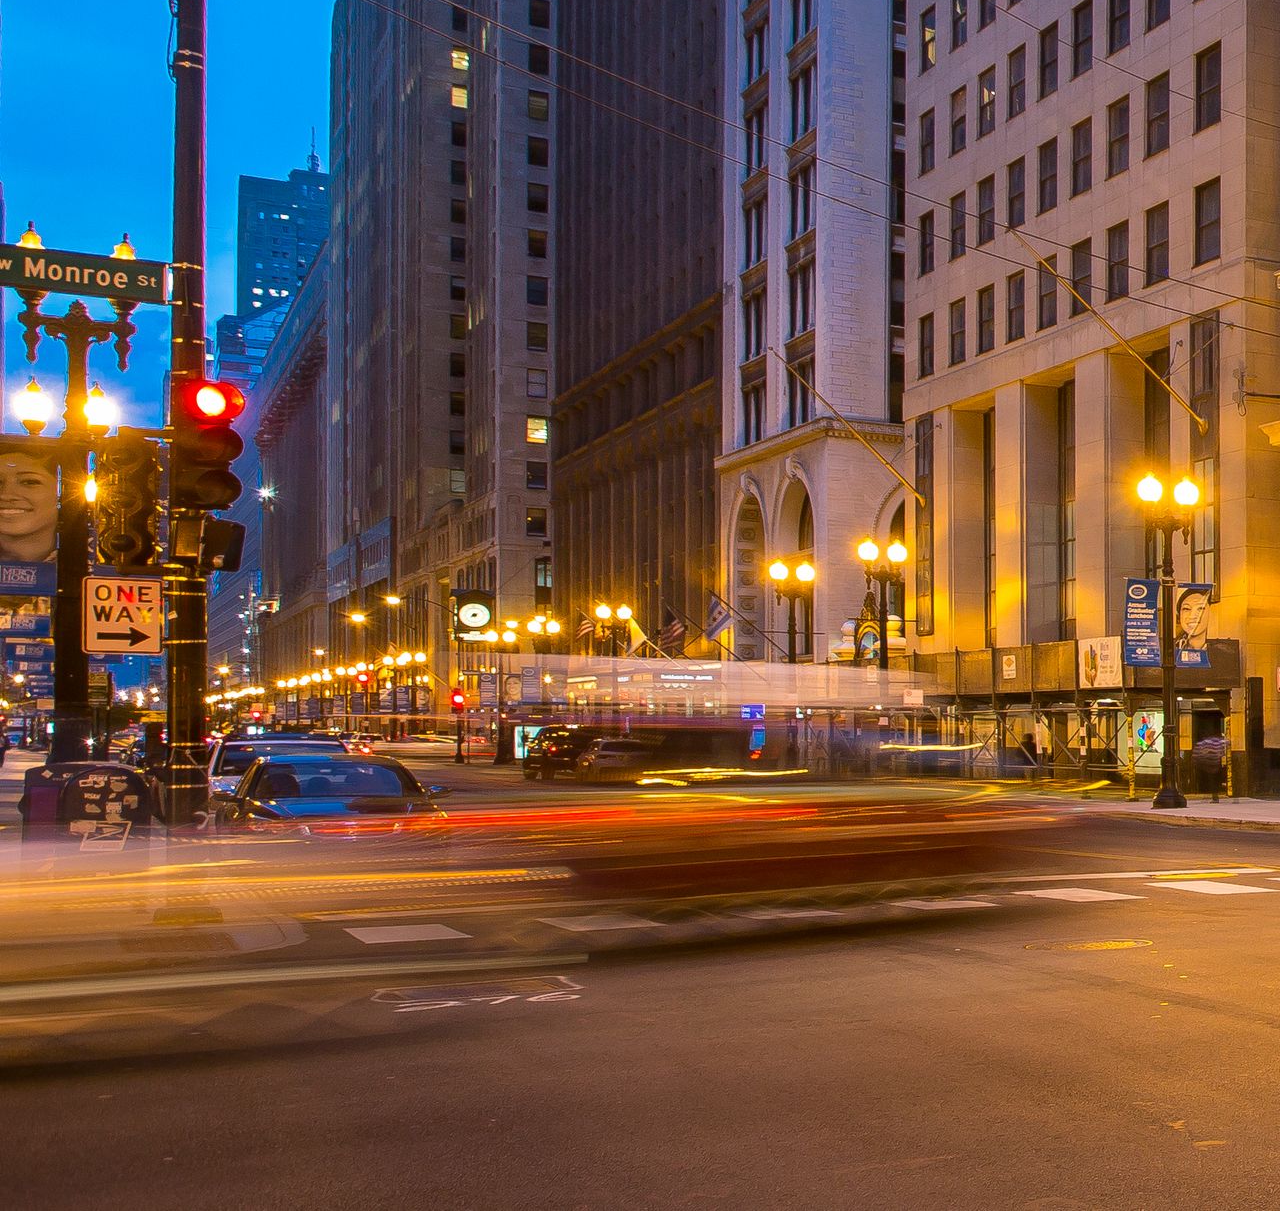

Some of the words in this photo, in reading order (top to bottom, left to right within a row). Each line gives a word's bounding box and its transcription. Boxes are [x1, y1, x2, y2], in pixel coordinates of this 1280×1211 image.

[24, 257, 129, 288] Monroe
[137, 275, 157, 288] St
[2, 566, 37, 577] MERCY
[2, 575, 37, 584] HOME
[95, 584, 153, 603] ONE
[93, 605, 154, 623] WAY
